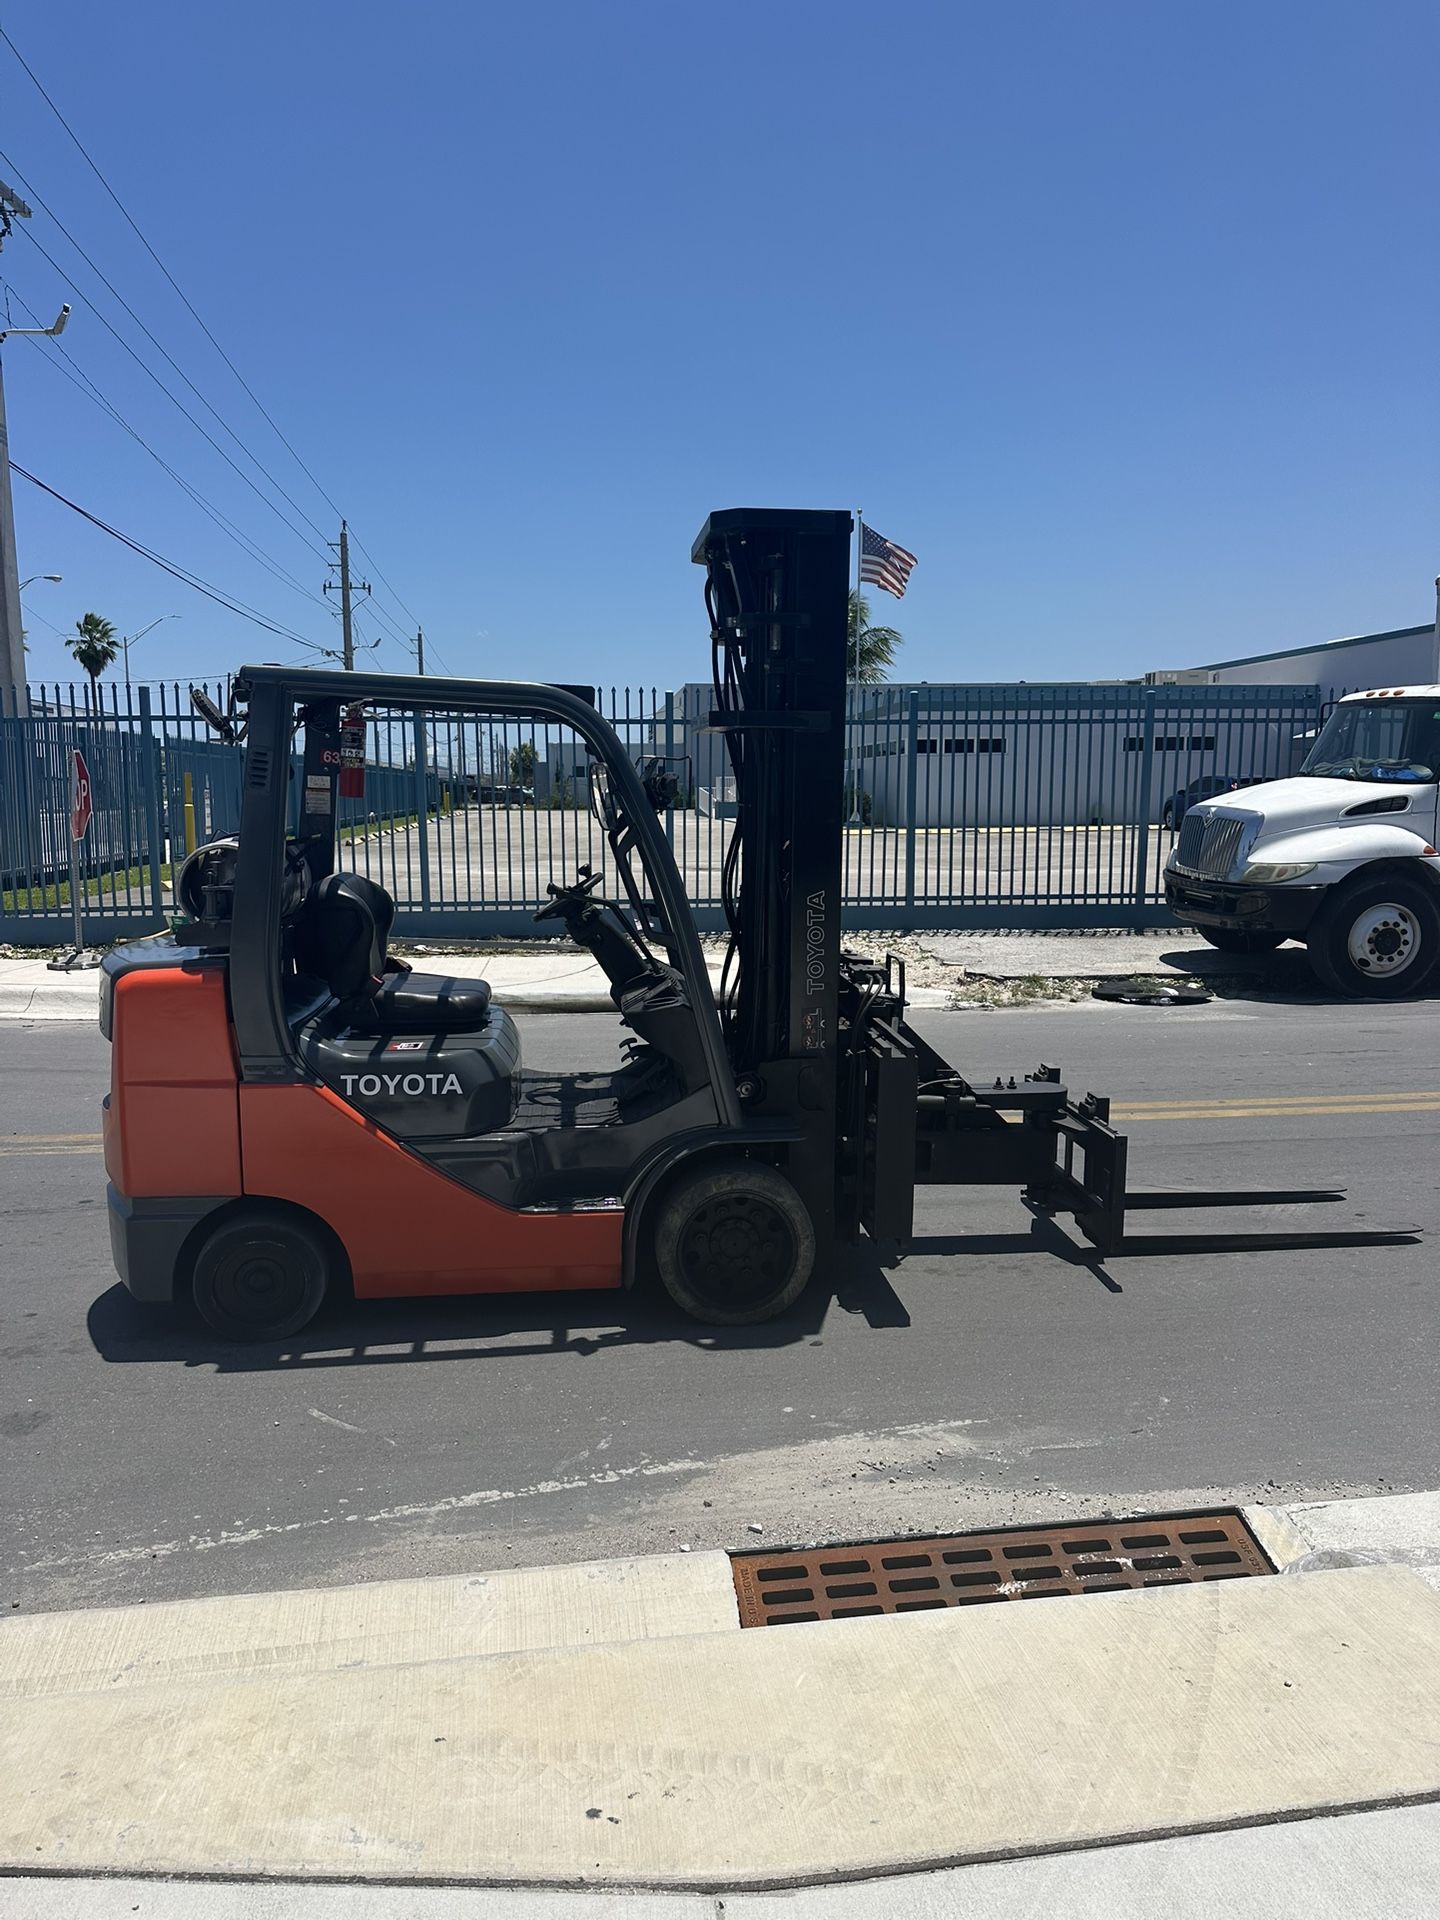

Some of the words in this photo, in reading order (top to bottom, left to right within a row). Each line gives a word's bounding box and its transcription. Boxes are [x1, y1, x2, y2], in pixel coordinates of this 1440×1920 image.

[807, 890, 825, 995] TOYOTA
[340, 1073, 463, 1096] TOYOTA
[740, 1568, 753, 1594] MADE
